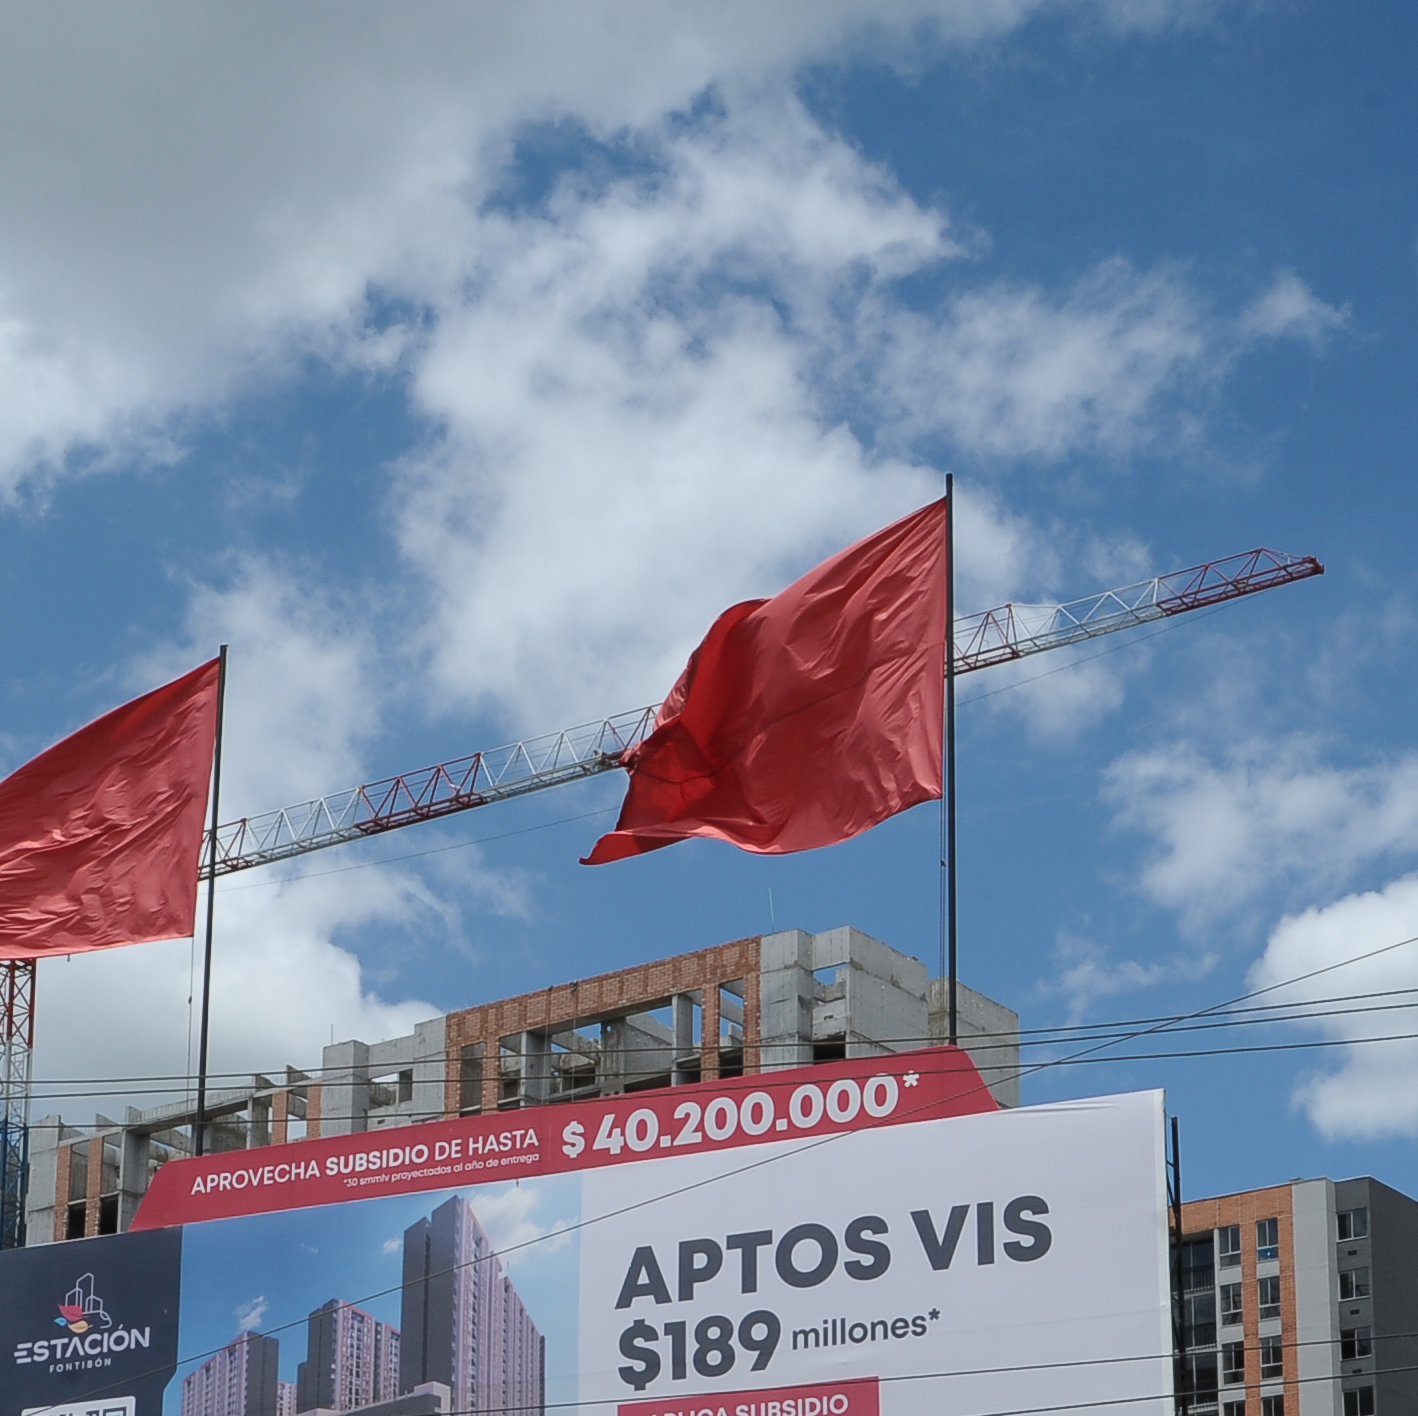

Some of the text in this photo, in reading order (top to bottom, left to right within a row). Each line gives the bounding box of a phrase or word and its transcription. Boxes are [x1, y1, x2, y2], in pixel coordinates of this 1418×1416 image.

[191, 1128, 539, 1195] APROVECHA SUBSIDIO DE HASTA
[391, 1164, 451, 1185] proyectados
[453, 1162, 463, 1172] al
[465, 1158, 484, 1172] año
[486, 1157, 499, 1168] de
[501, 1153, 539, 1168] entrega
[614, 1195, 1052, 1310] APTOS VIS
[14, 1324, 150, 1364] ESTACIÓN
[49, 1357, 112, 1373] FONTIBÓN
[617, 1309, 781, 1391] $189
